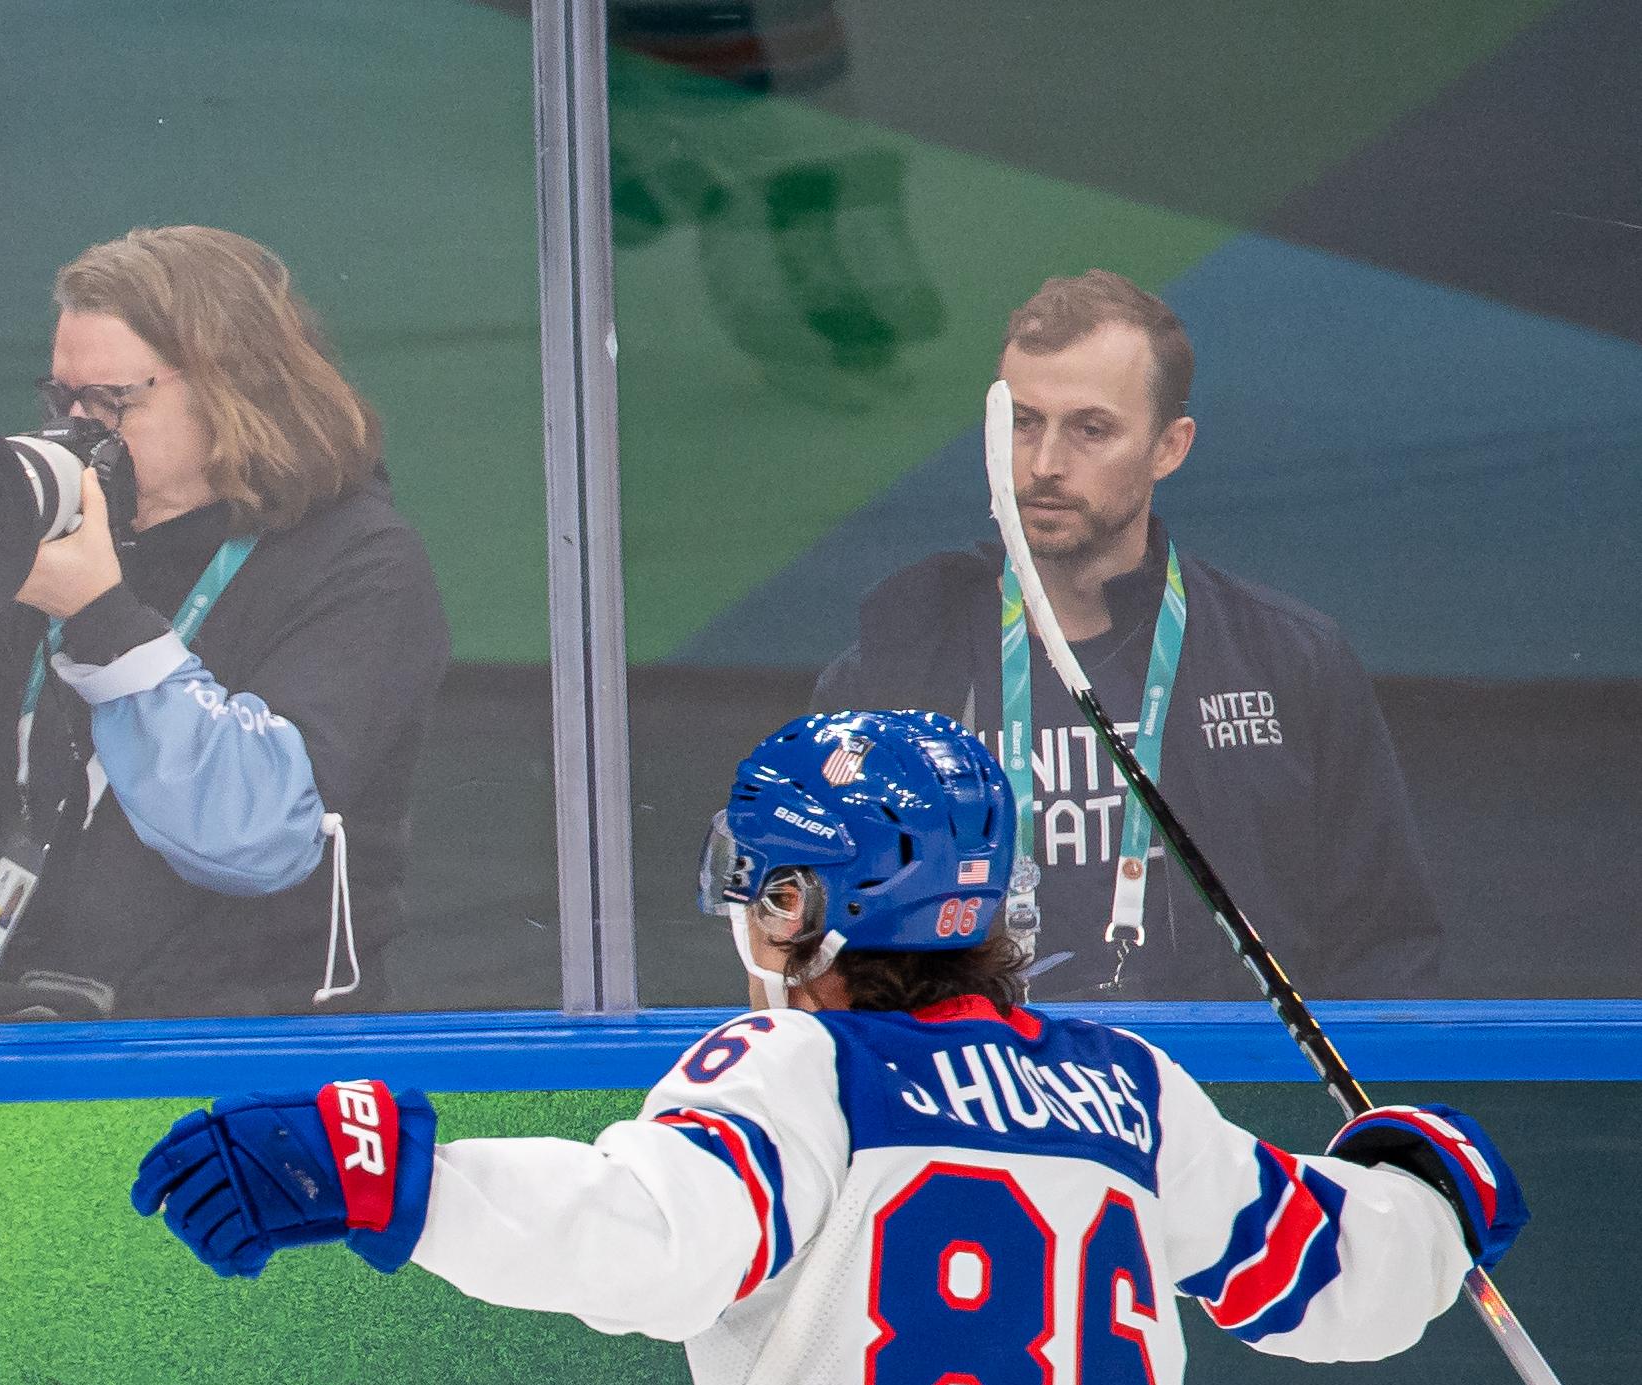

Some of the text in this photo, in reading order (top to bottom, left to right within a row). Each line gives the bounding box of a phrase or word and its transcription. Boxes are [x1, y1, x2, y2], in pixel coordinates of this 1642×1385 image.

[1199, 691, 1275, 721] NITED
[1201, 718, 1283, 749] TATES
[774, 806, 836, 839] BAUER
[936, 897, 983, 937] 86
